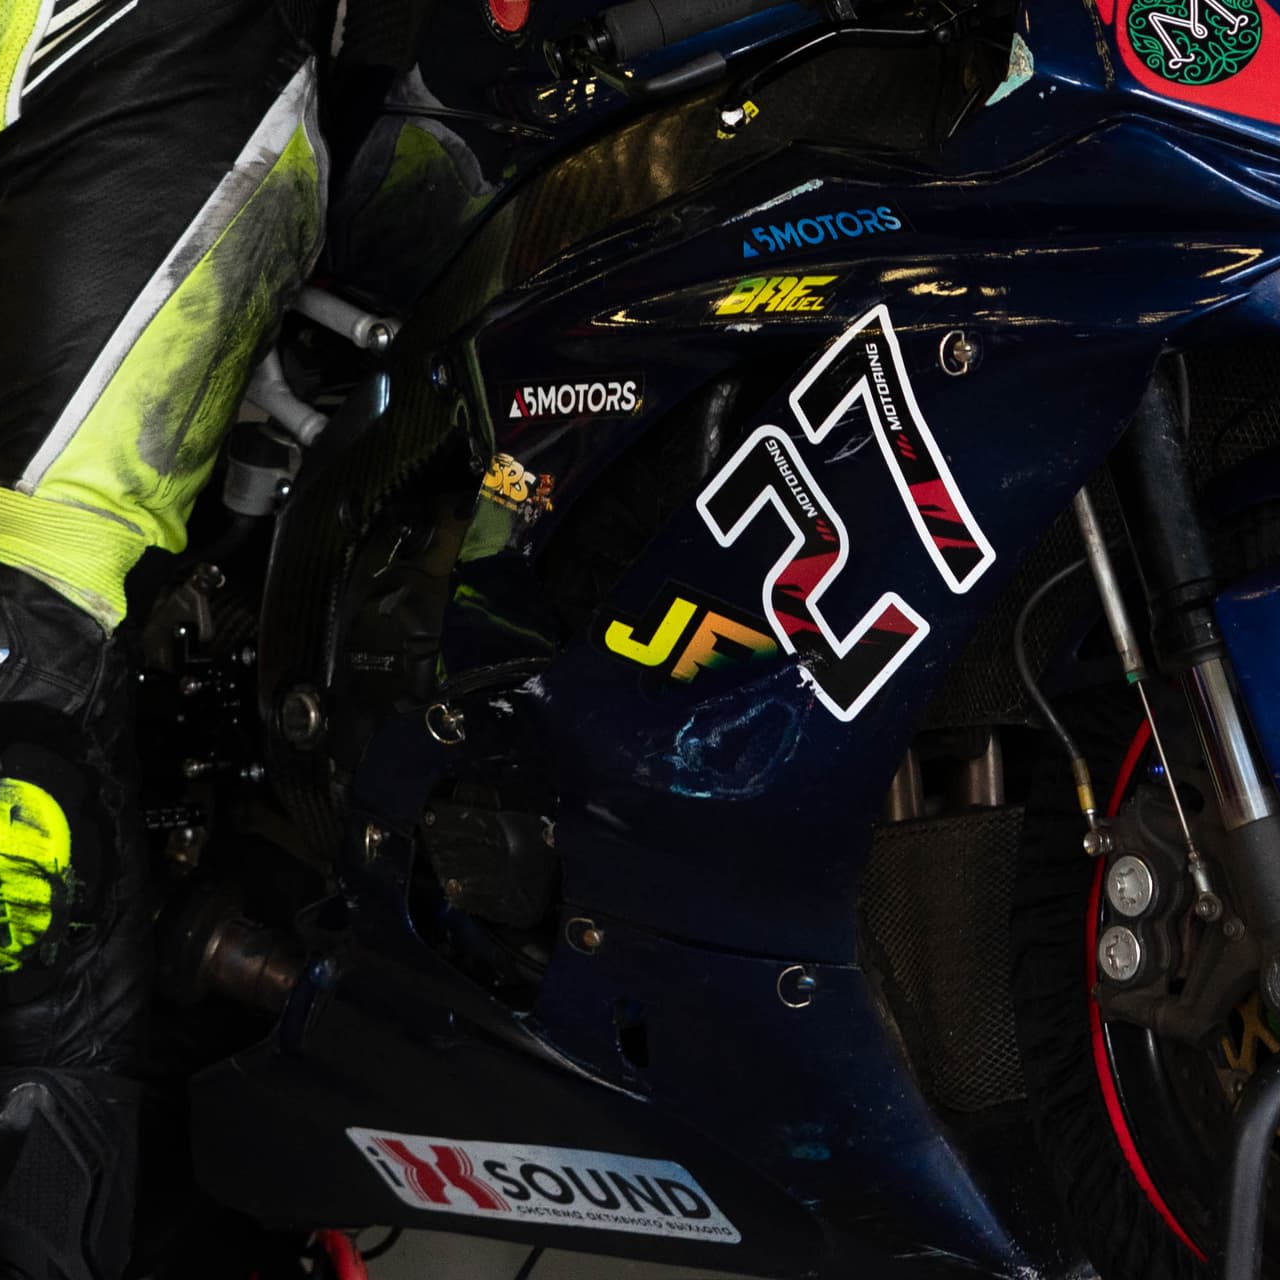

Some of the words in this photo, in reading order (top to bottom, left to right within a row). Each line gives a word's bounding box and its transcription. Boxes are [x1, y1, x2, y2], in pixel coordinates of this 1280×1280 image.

[865, 342, 903, 432] MOTORING
[696, 303, 997, 722] 27
[764, 438, 819, 519] MOTORING
